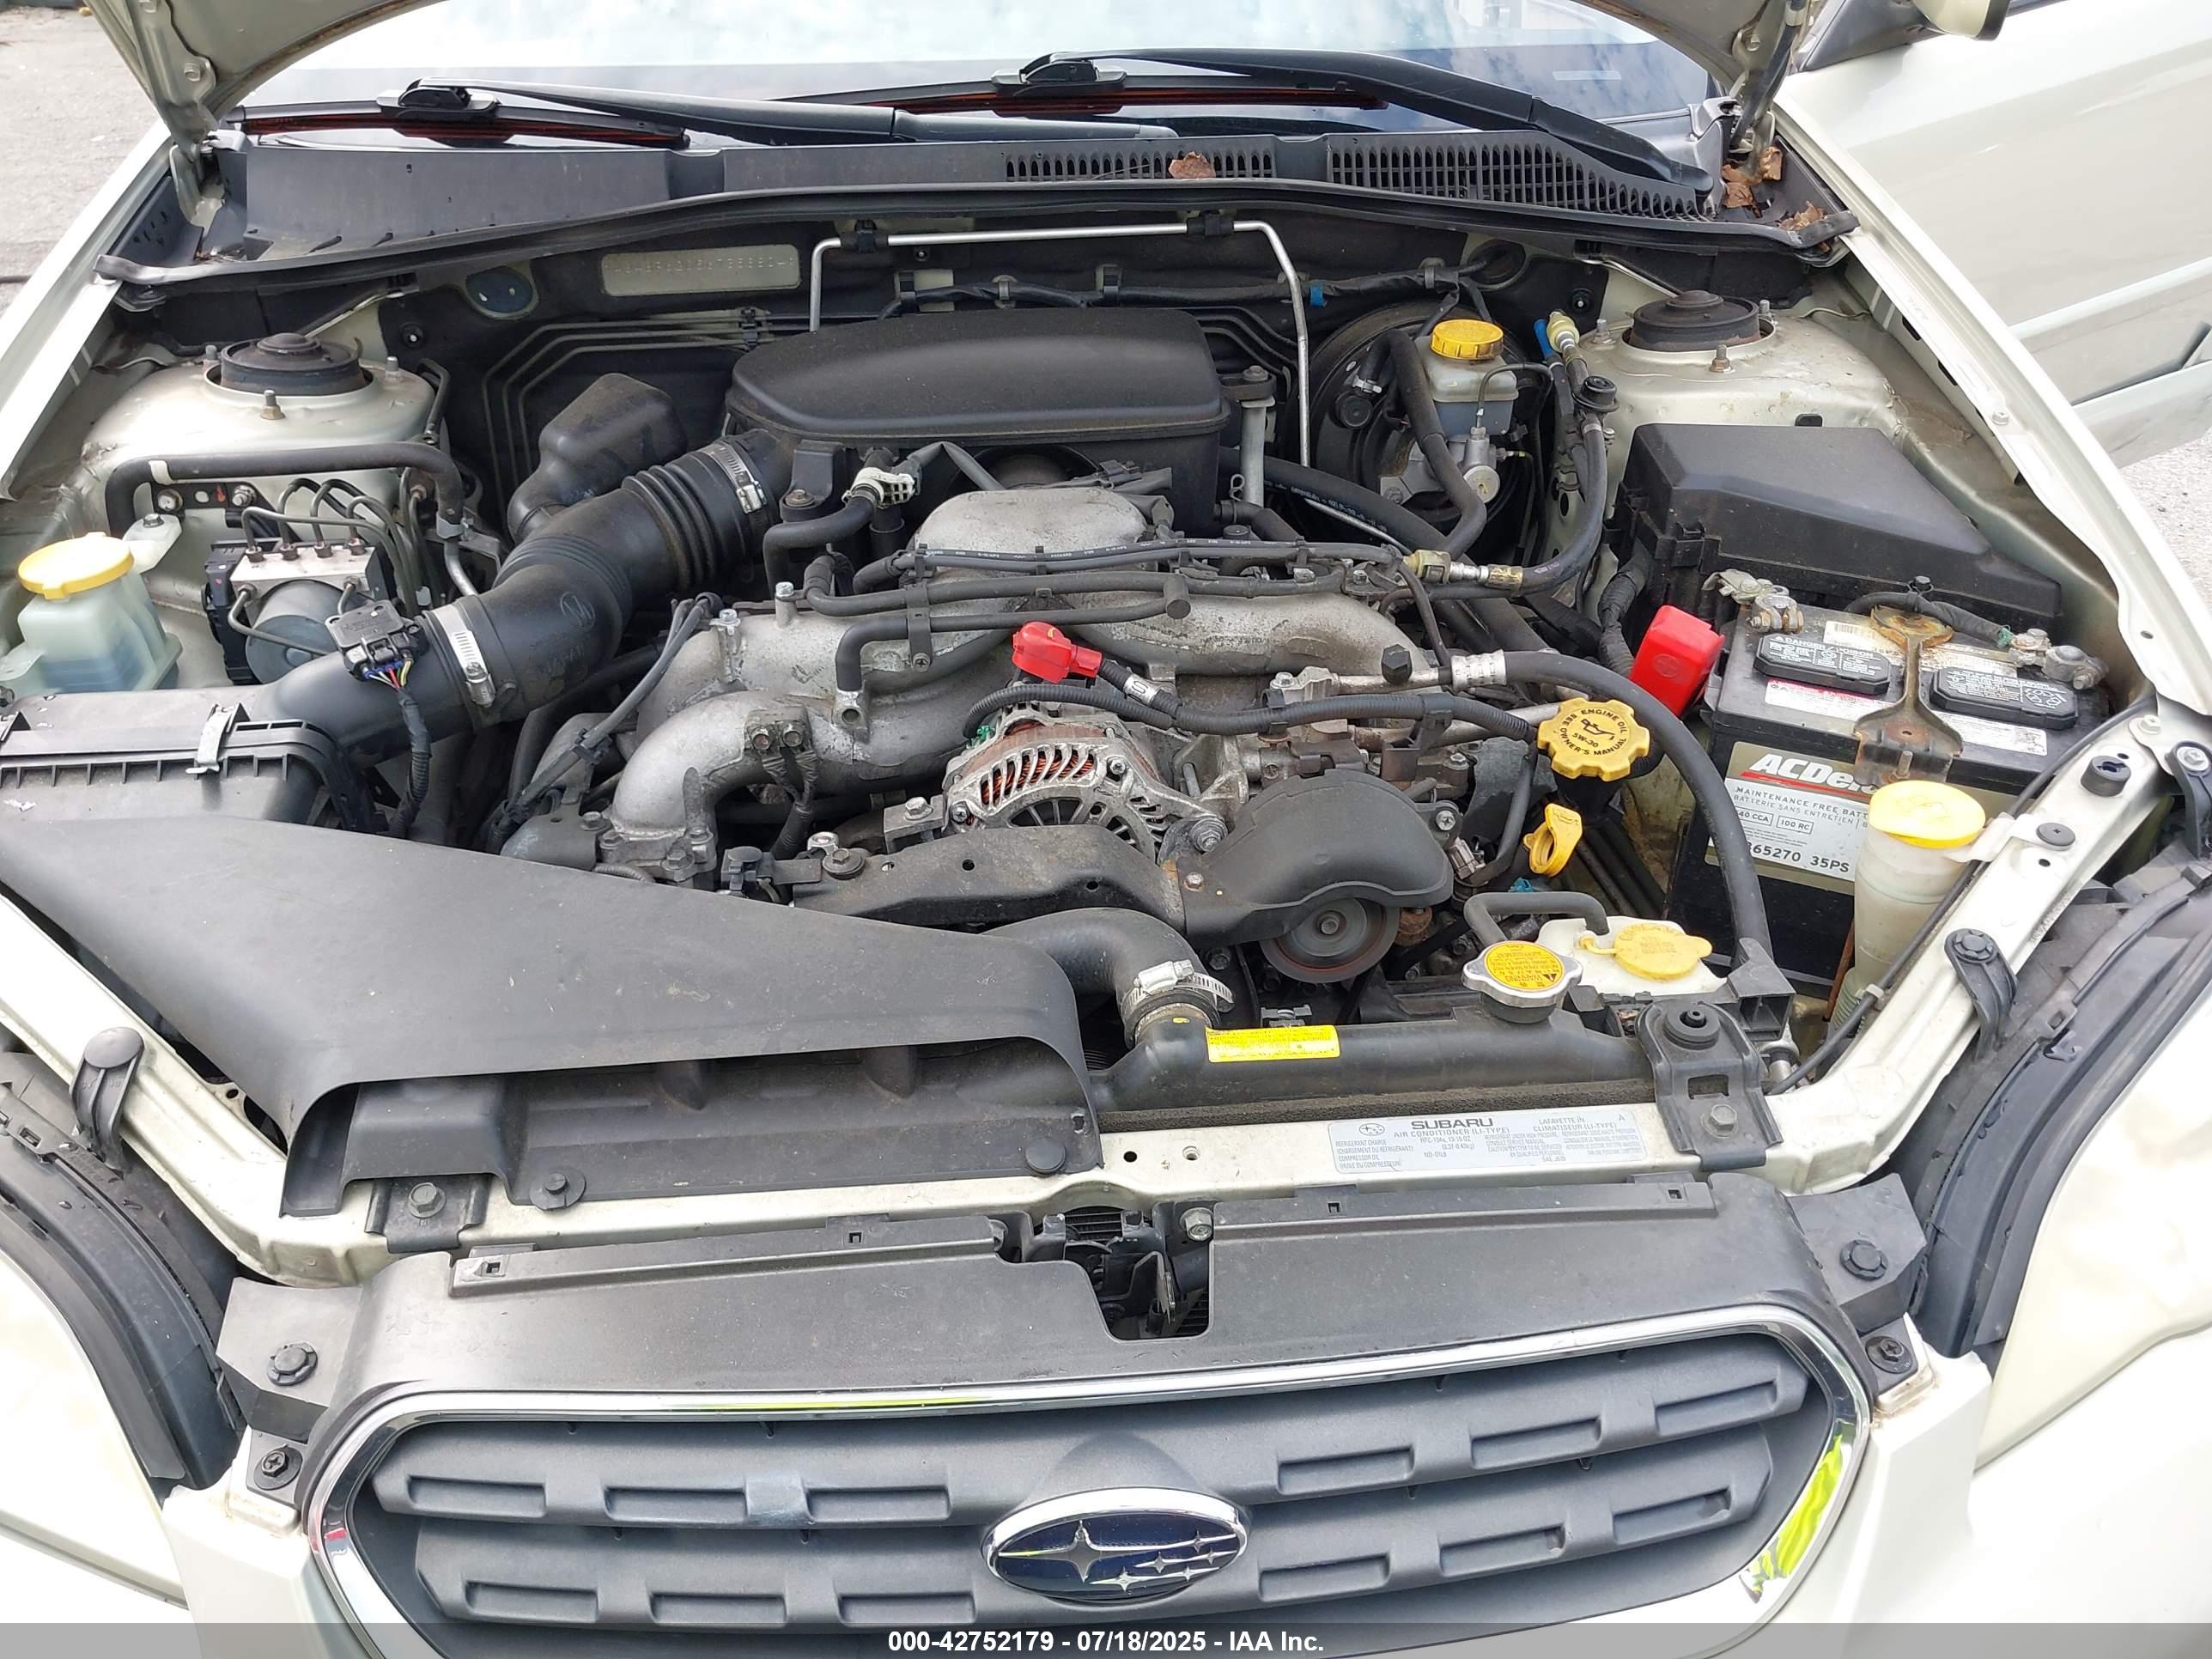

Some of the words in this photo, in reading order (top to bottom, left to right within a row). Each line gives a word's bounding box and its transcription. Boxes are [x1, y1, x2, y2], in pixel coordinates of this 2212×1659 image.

[1563, 714, 1578, 726] SEE
[1581, 708, 1620, 720] ENGINE
[1619, 719, 1628, 733] OIL
[1559, 727, 1589, 755] OWNER'S
[1572, 732, 1599, 748] 5W-30
[1594, 737, 1627, 756] MANUAL
[1735, 786, 1809, 807] MAINTENANCE
[1813, 802, 1838, 814] FREE
[1734, 794, 1774, 808] BATTERIE
[1778, 804, 1801, 814] SANS
[1804, 809, 1854, 824] ENTRETIEN
[1737, 811, 1750, 819] 40
[1752, 813, 1769, 823] CCA
[1781, 819, 1796, 828] 100
[1798, 822, 1810, 830] RC
[1810, 854, 1850, 873] 35PS
[1411, 1118, 1493, 1129] SUBARU
[1411, 1129, 1470, 1138] CONDITIONER
